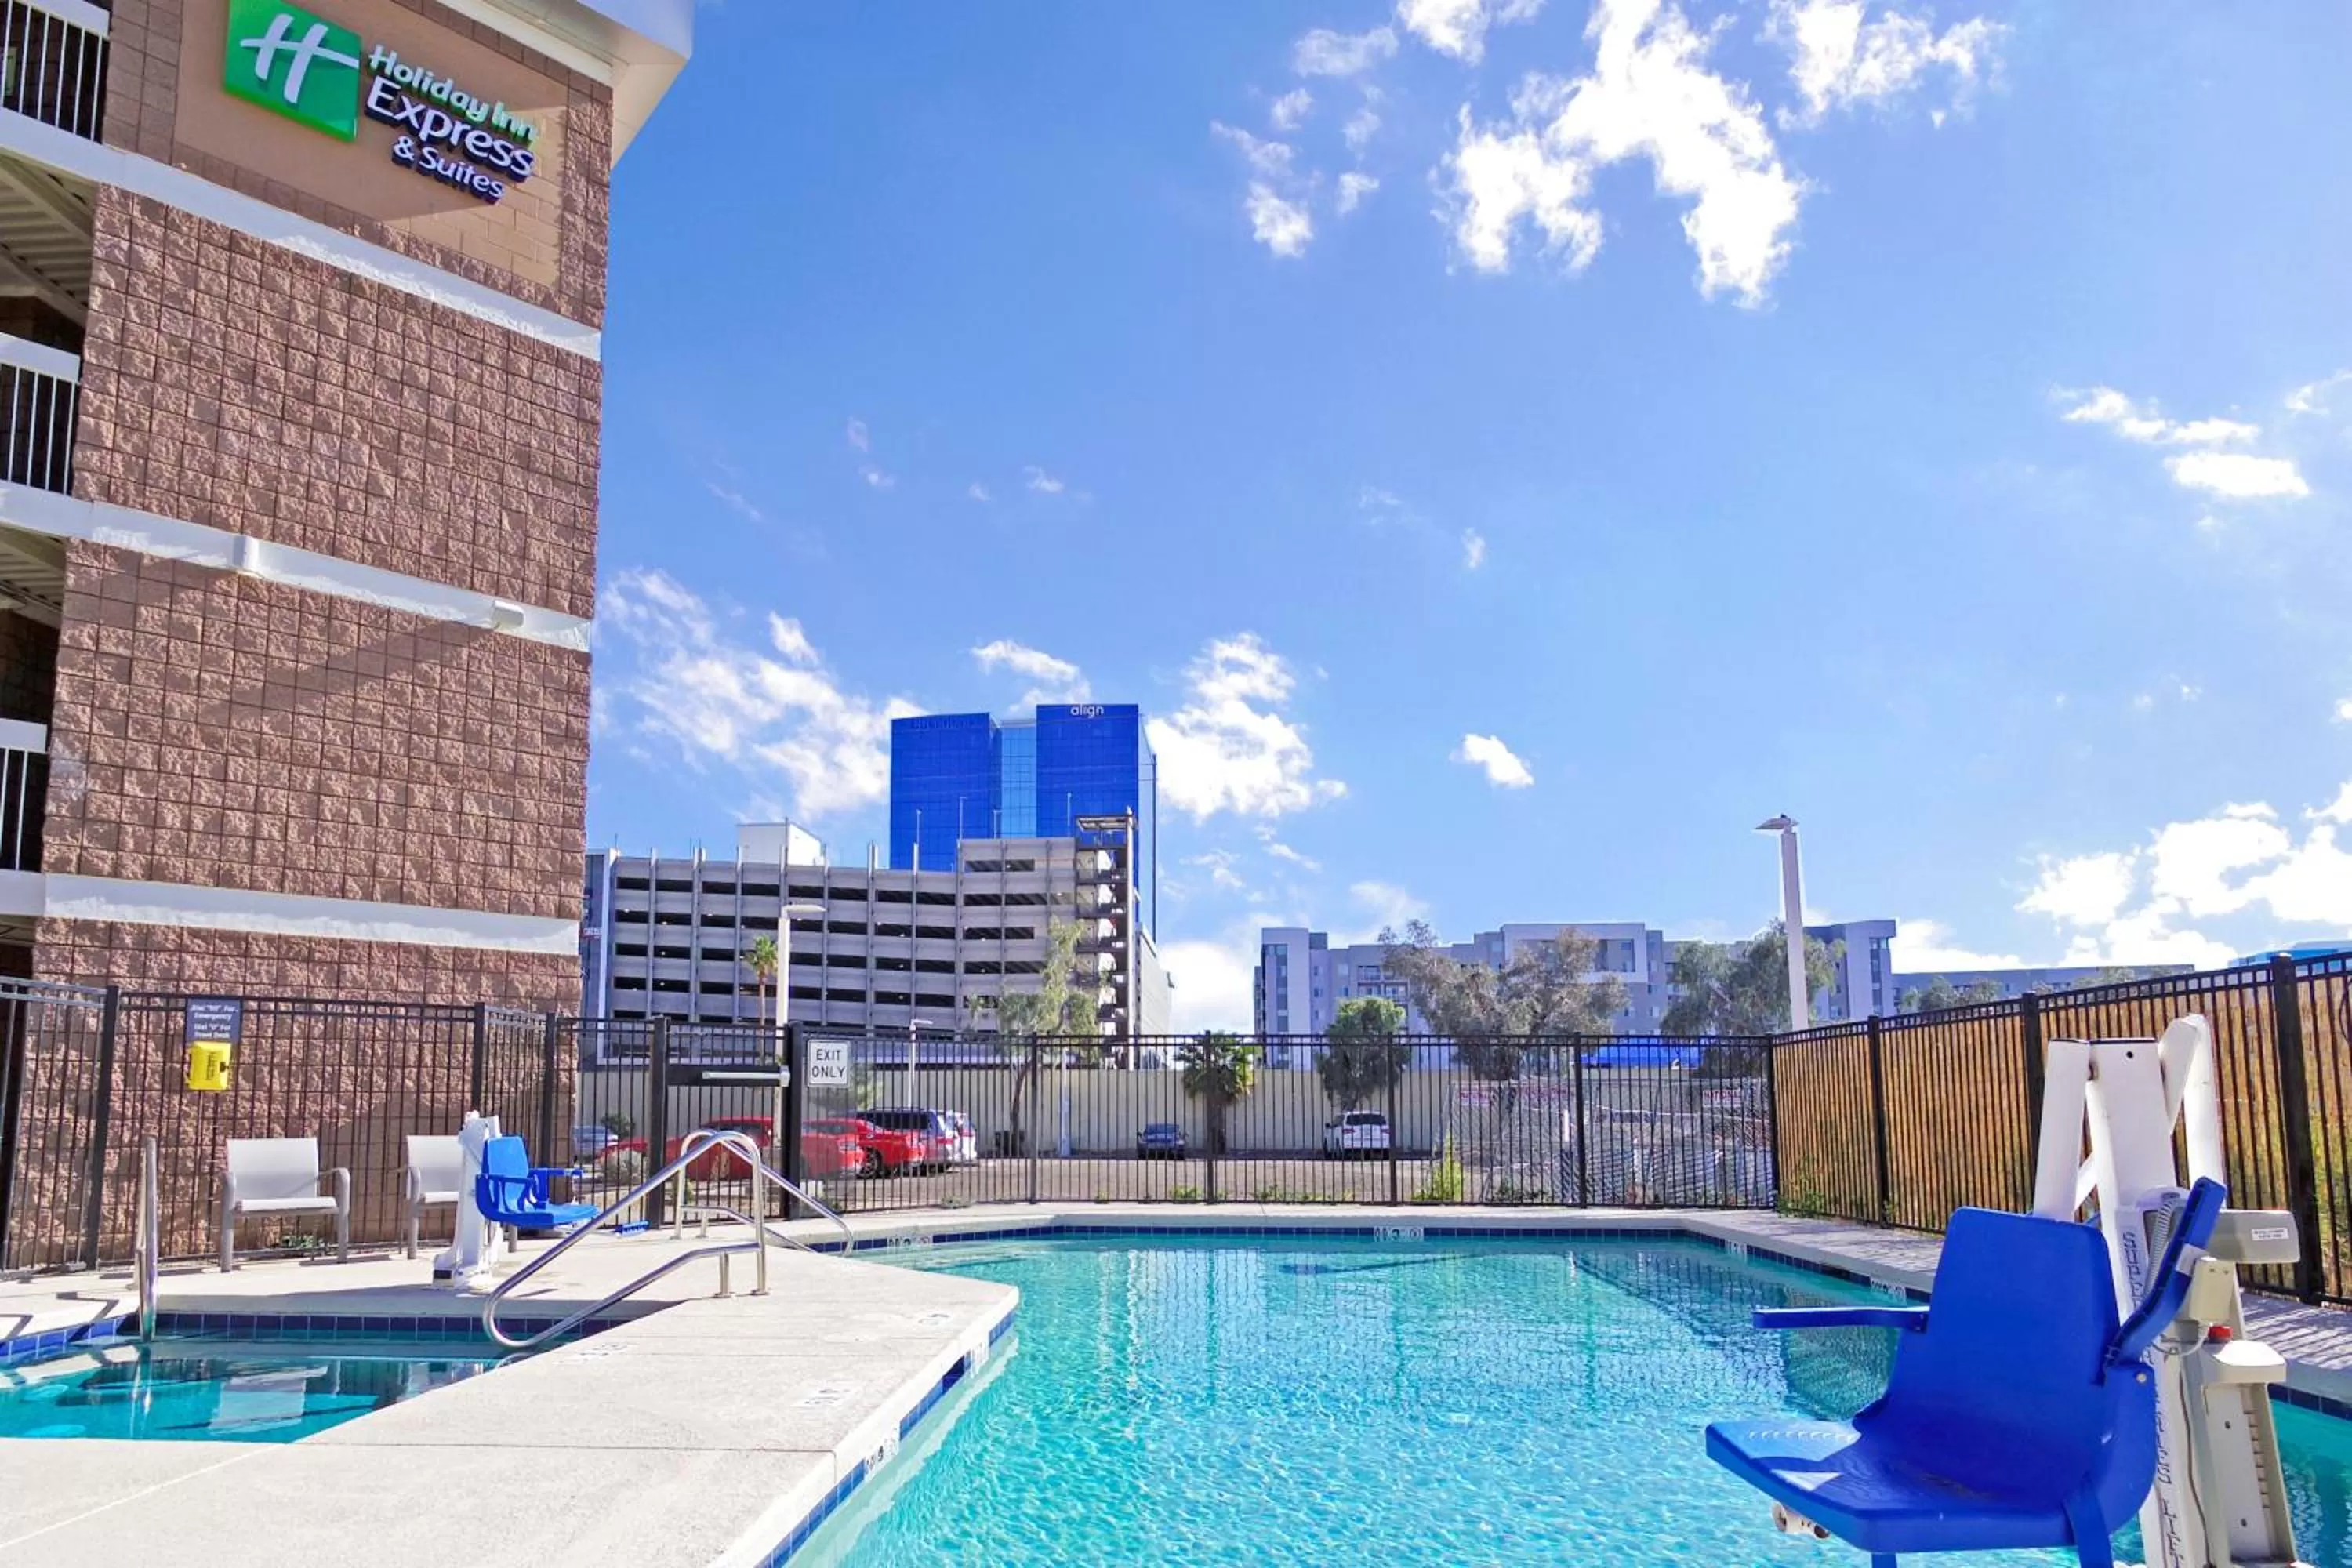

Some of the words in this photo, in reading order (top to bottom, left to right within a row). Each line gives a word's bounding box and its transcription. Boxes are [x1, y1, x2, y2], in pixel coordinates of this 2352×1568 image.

[368, 44, 490, 125] Holiday
[492, 100, 539, 144] Inn
[366, 75, 535, 178] Express
[392, 136, 415, 162] &
[418, 146, 504, 198] Suites
[1070, 703, 1105, 719] align
[811, 1065, 846, 1078] ONLY
[816, 1049, 843, 1061] EXIT
